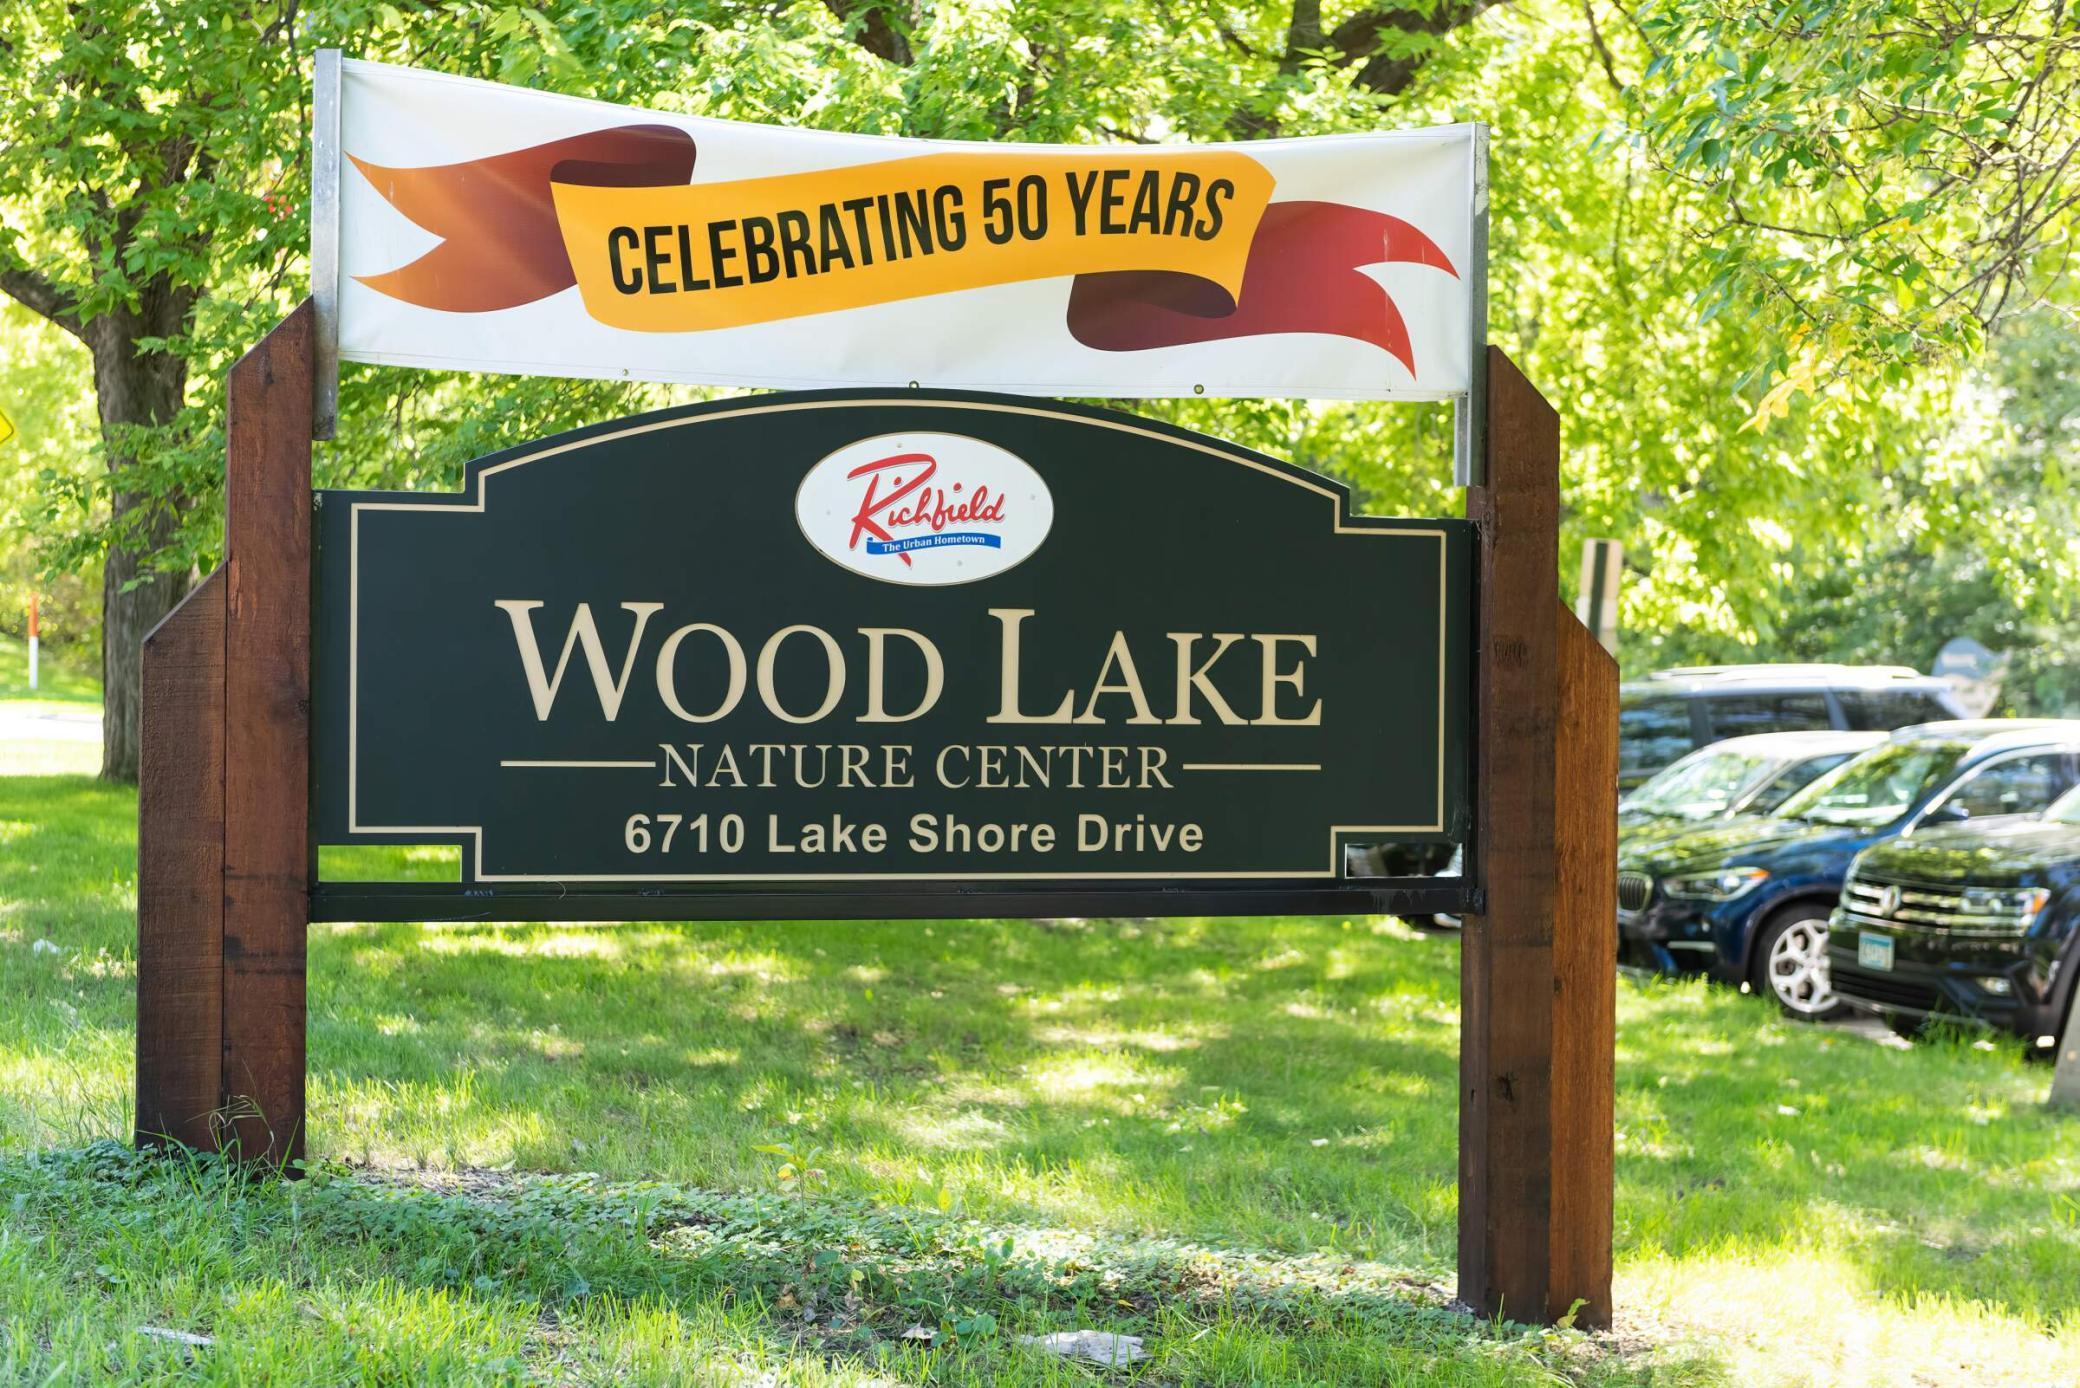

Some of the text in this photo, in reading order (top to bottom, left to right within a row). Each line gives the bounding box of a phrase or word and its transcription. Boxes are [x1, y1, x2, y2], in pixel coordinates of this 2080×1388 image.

[608, 169, 1235, 295] CELEBRATING 50 YEARS
[847, 453, 1005, 567] Richfield
[882, 535, 986, 553] The Urban Hometown
[494, 599, 1322, 726] WOOD LAKE
[658, 743, 1174, 789] NATURE CENTER
[625, 813, 1203, 854] 6710 Lake Shore Drive
